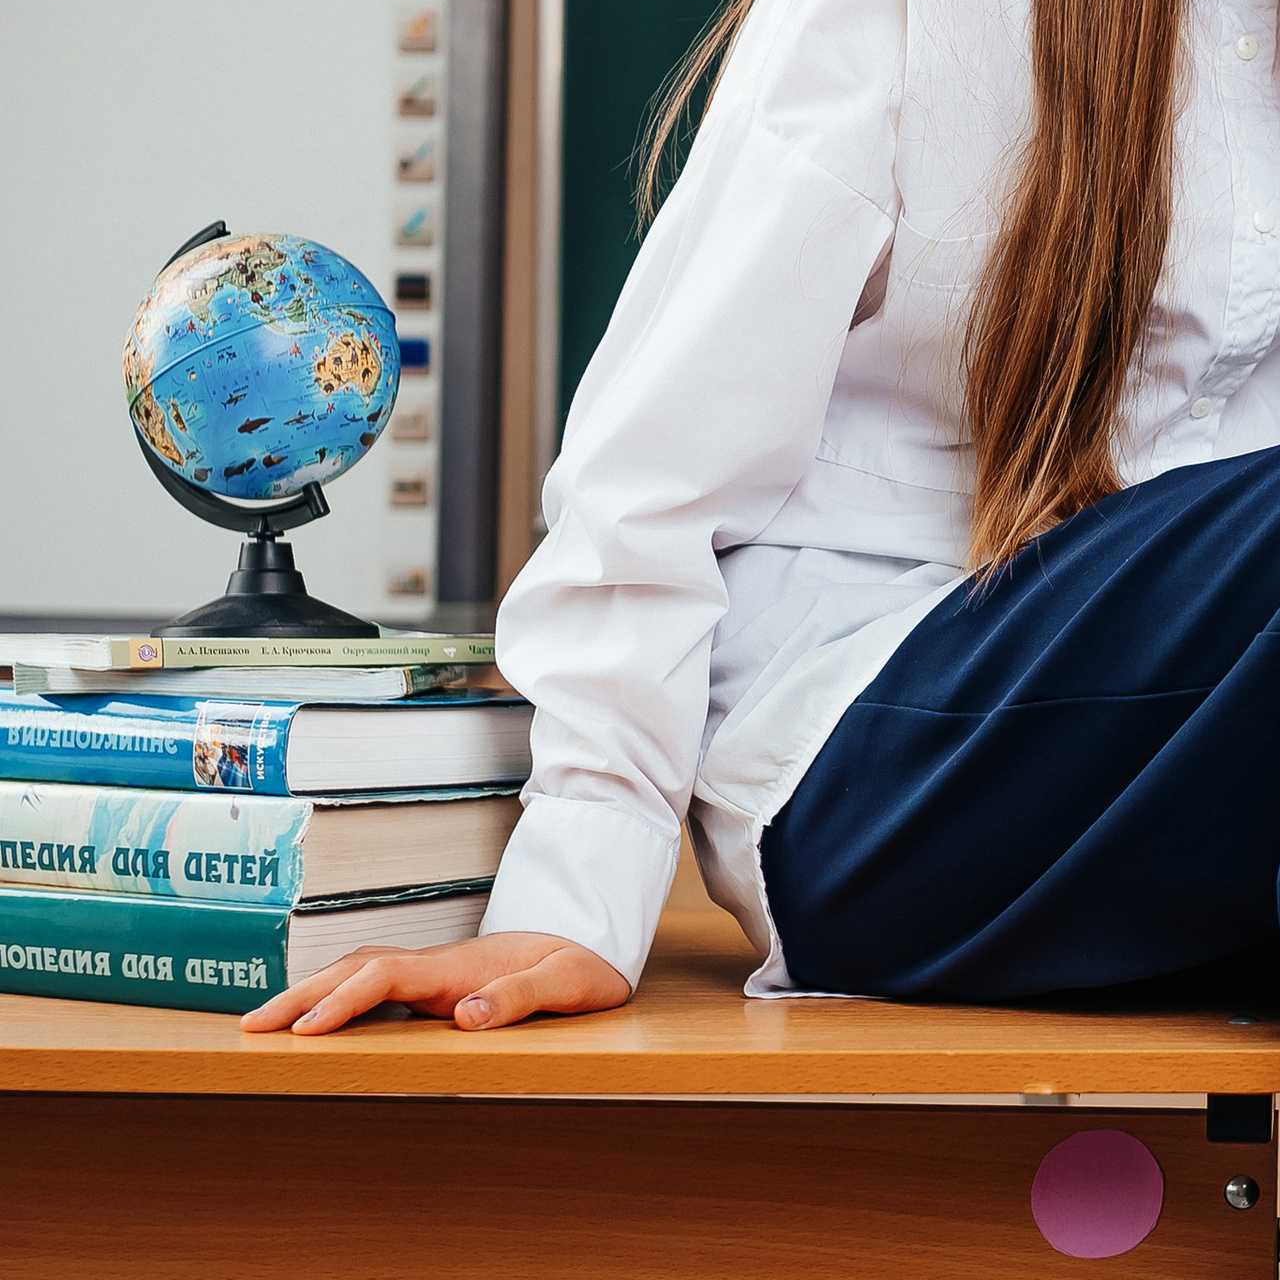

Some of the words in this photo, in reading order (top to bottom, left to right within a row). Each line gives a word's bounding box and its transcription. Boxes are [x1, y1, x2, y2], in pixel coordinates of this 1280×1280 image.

[199, 646, 250, 656] Плешаков
[282, 646, 332, 657] Крючкова
[342, 646, 409, 657] Окружающий
[411, 647, 431, 657] мир
[255, 711, 271, 780] ИСКУСТВО
[0, 840, 97, 874] ПЕДИЯ
[112, 847, 171, 879] ДЛЯ
[184, 848, 280, 887] ДЕТЕЙ
[121, 953, 174, 981] ДЛЯ
[184, 957, 268, 989] ДЕТЕЙ
